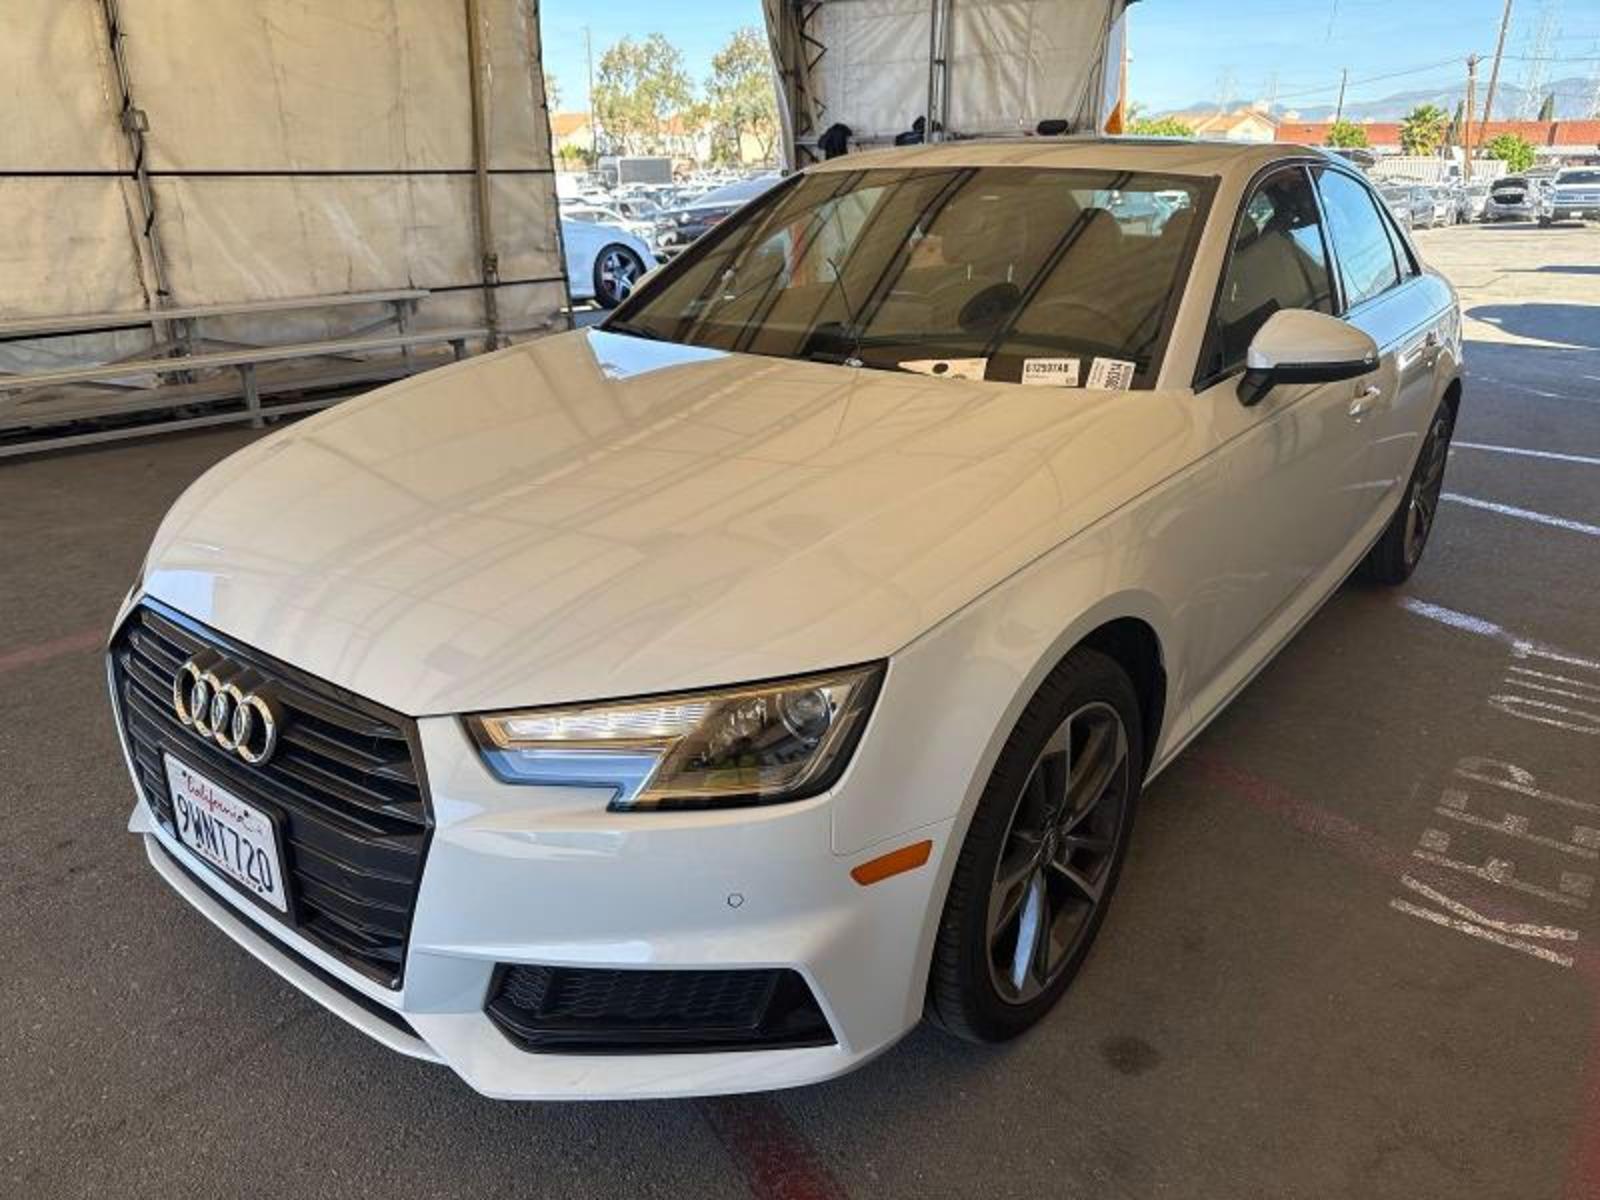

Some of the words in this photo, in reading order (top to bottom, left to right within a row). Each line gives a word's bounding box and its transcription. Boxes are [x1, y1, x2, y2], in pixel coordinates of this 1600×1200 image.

[178, 793, 274, 893] 9WNT720
[187, 775, 244, 823] California
[1389, 756, 1600, 967] KEEP
